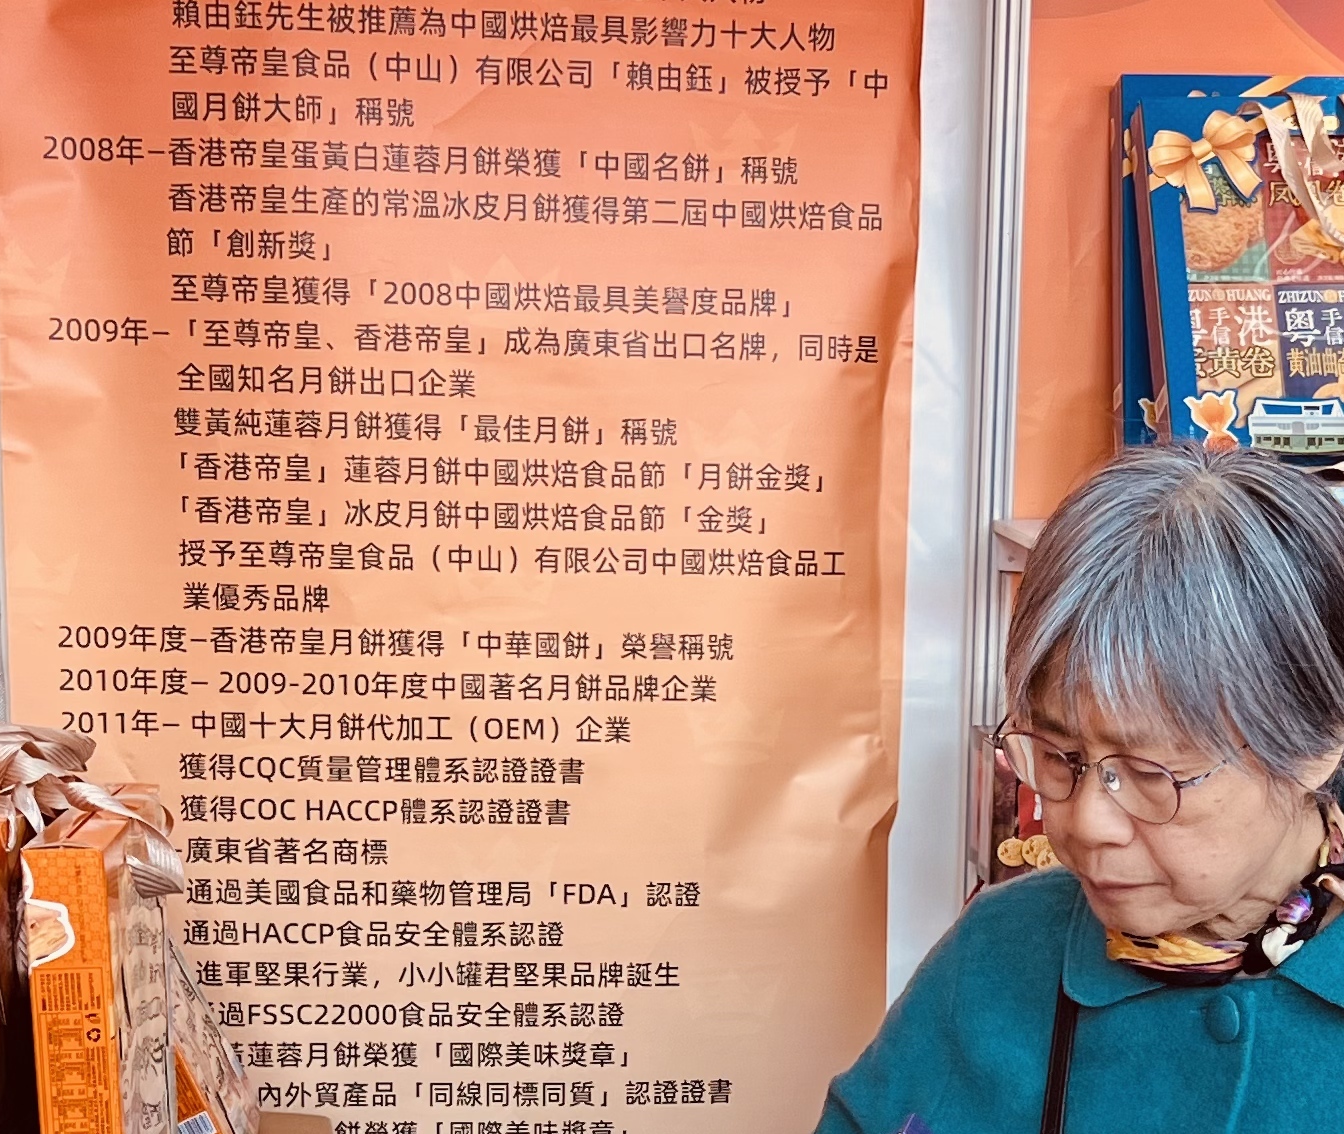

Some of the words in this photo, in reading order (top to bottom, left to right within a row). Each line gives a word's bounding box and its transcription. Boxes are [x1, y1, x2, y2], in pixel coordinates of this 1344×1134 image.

[1278, 290, 1324, 304] ZHIZUN
[177, 363, 476, 399] 全國知名月餅出口企業
[182, 581, 331, 614] 業優秀品牌
